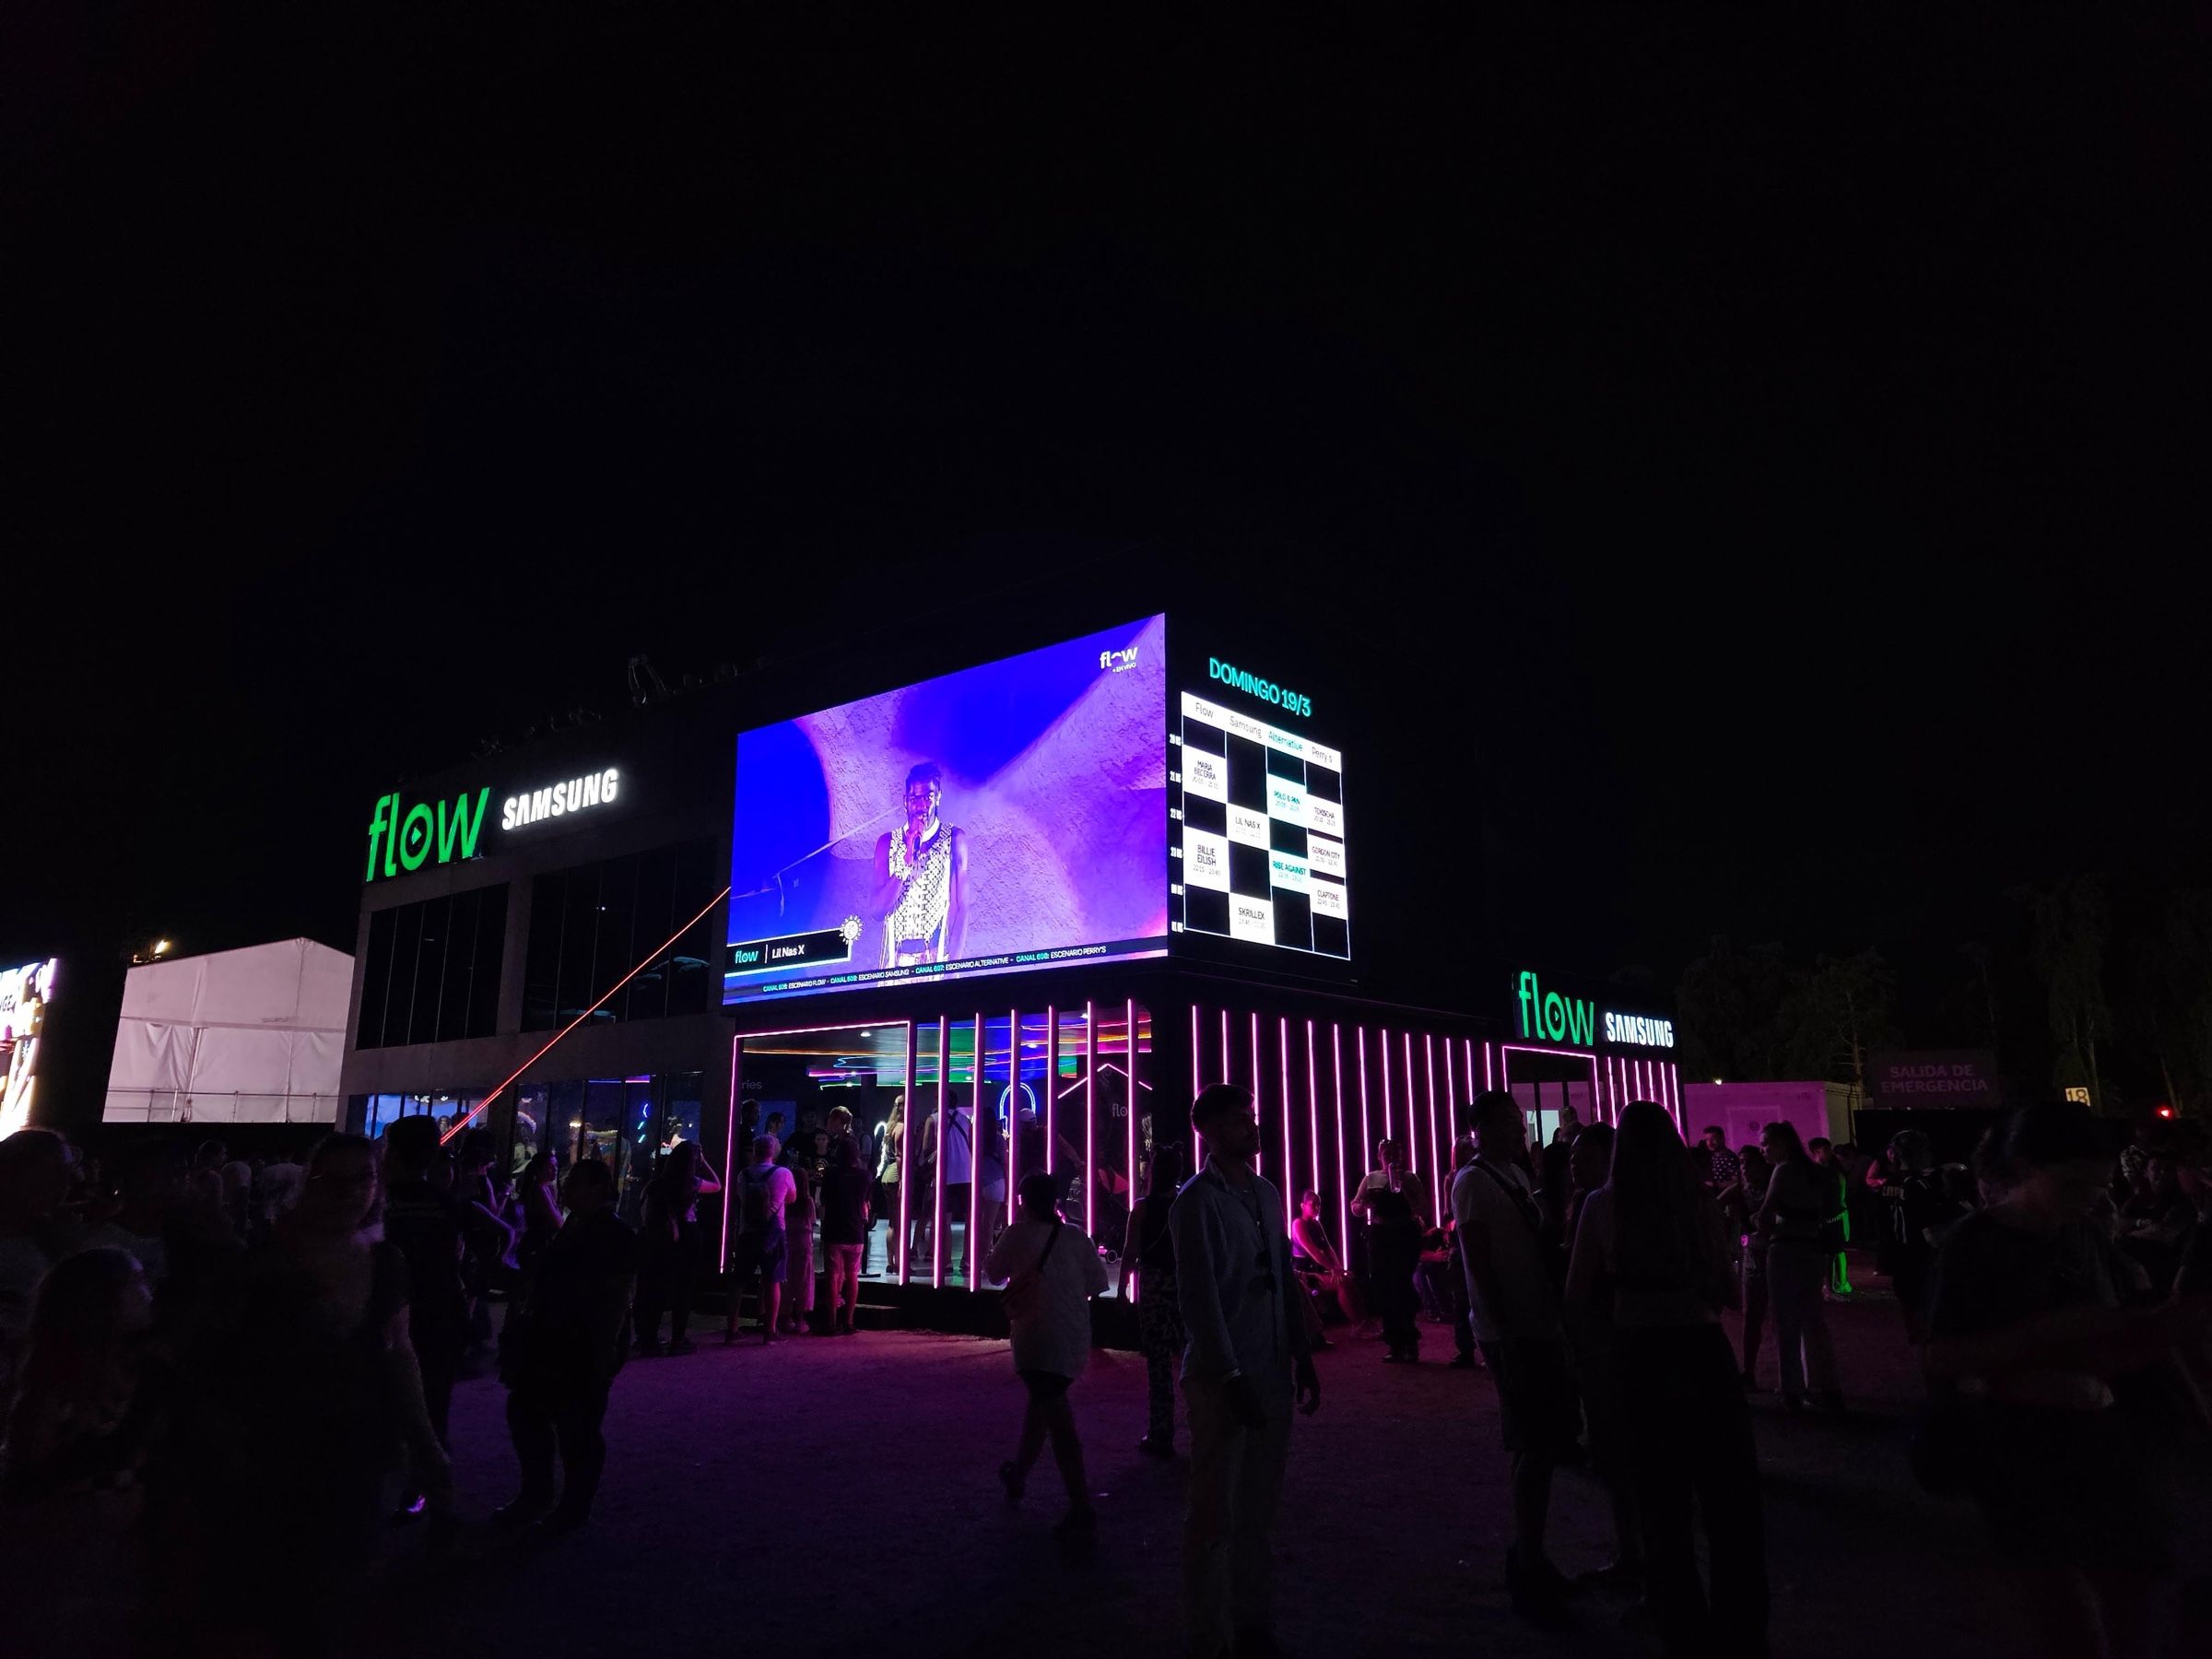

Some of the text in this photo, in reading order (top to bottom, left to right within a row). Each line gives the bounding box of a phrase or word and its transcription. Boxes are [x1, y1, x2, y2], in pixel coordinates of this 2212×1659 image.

[1100, 647, 1138, 669] flow
[1209, 657, 1312, 717] DOMINGO 19/3
[1194, 701, 1214, 719] Flow
[1229, 715, 1263, 738] Samsung
[365, 768, 618, 883] flow SAMSUNG
[1197, 844, 1216, 857] BILLIE
[1197, 854, 1217, 866] EILISH
[1238, 907, 1265, 921] SKRILLEX
[735, 950, 759, 964] flow
[772, 944, 805, 959] Lil Nas X
[813, 979, 827, 987] FLOW
[858, 972, 885, 981] ESCENARIO
[885, 969, 910, 978] SAMSUNG
[946, 960, 974, 971] ESCENARIO
[974, 957, 1009, 967] ALTERNATIVE
[1016, 954, 1036, 962] CANAL
[1051, 948, 1083, 959] ESCENARIO
[1083, 946, 1107, 956] PERRY'S
[1518, 971, 1675, 1049] flow SAMSUNG
[1888, 1064, 1974, 1078] SALIDA DE
[1880, 1078, 1989, 1093] EMERGENCIA
[1112, 1102, 1129, 1118] flo
